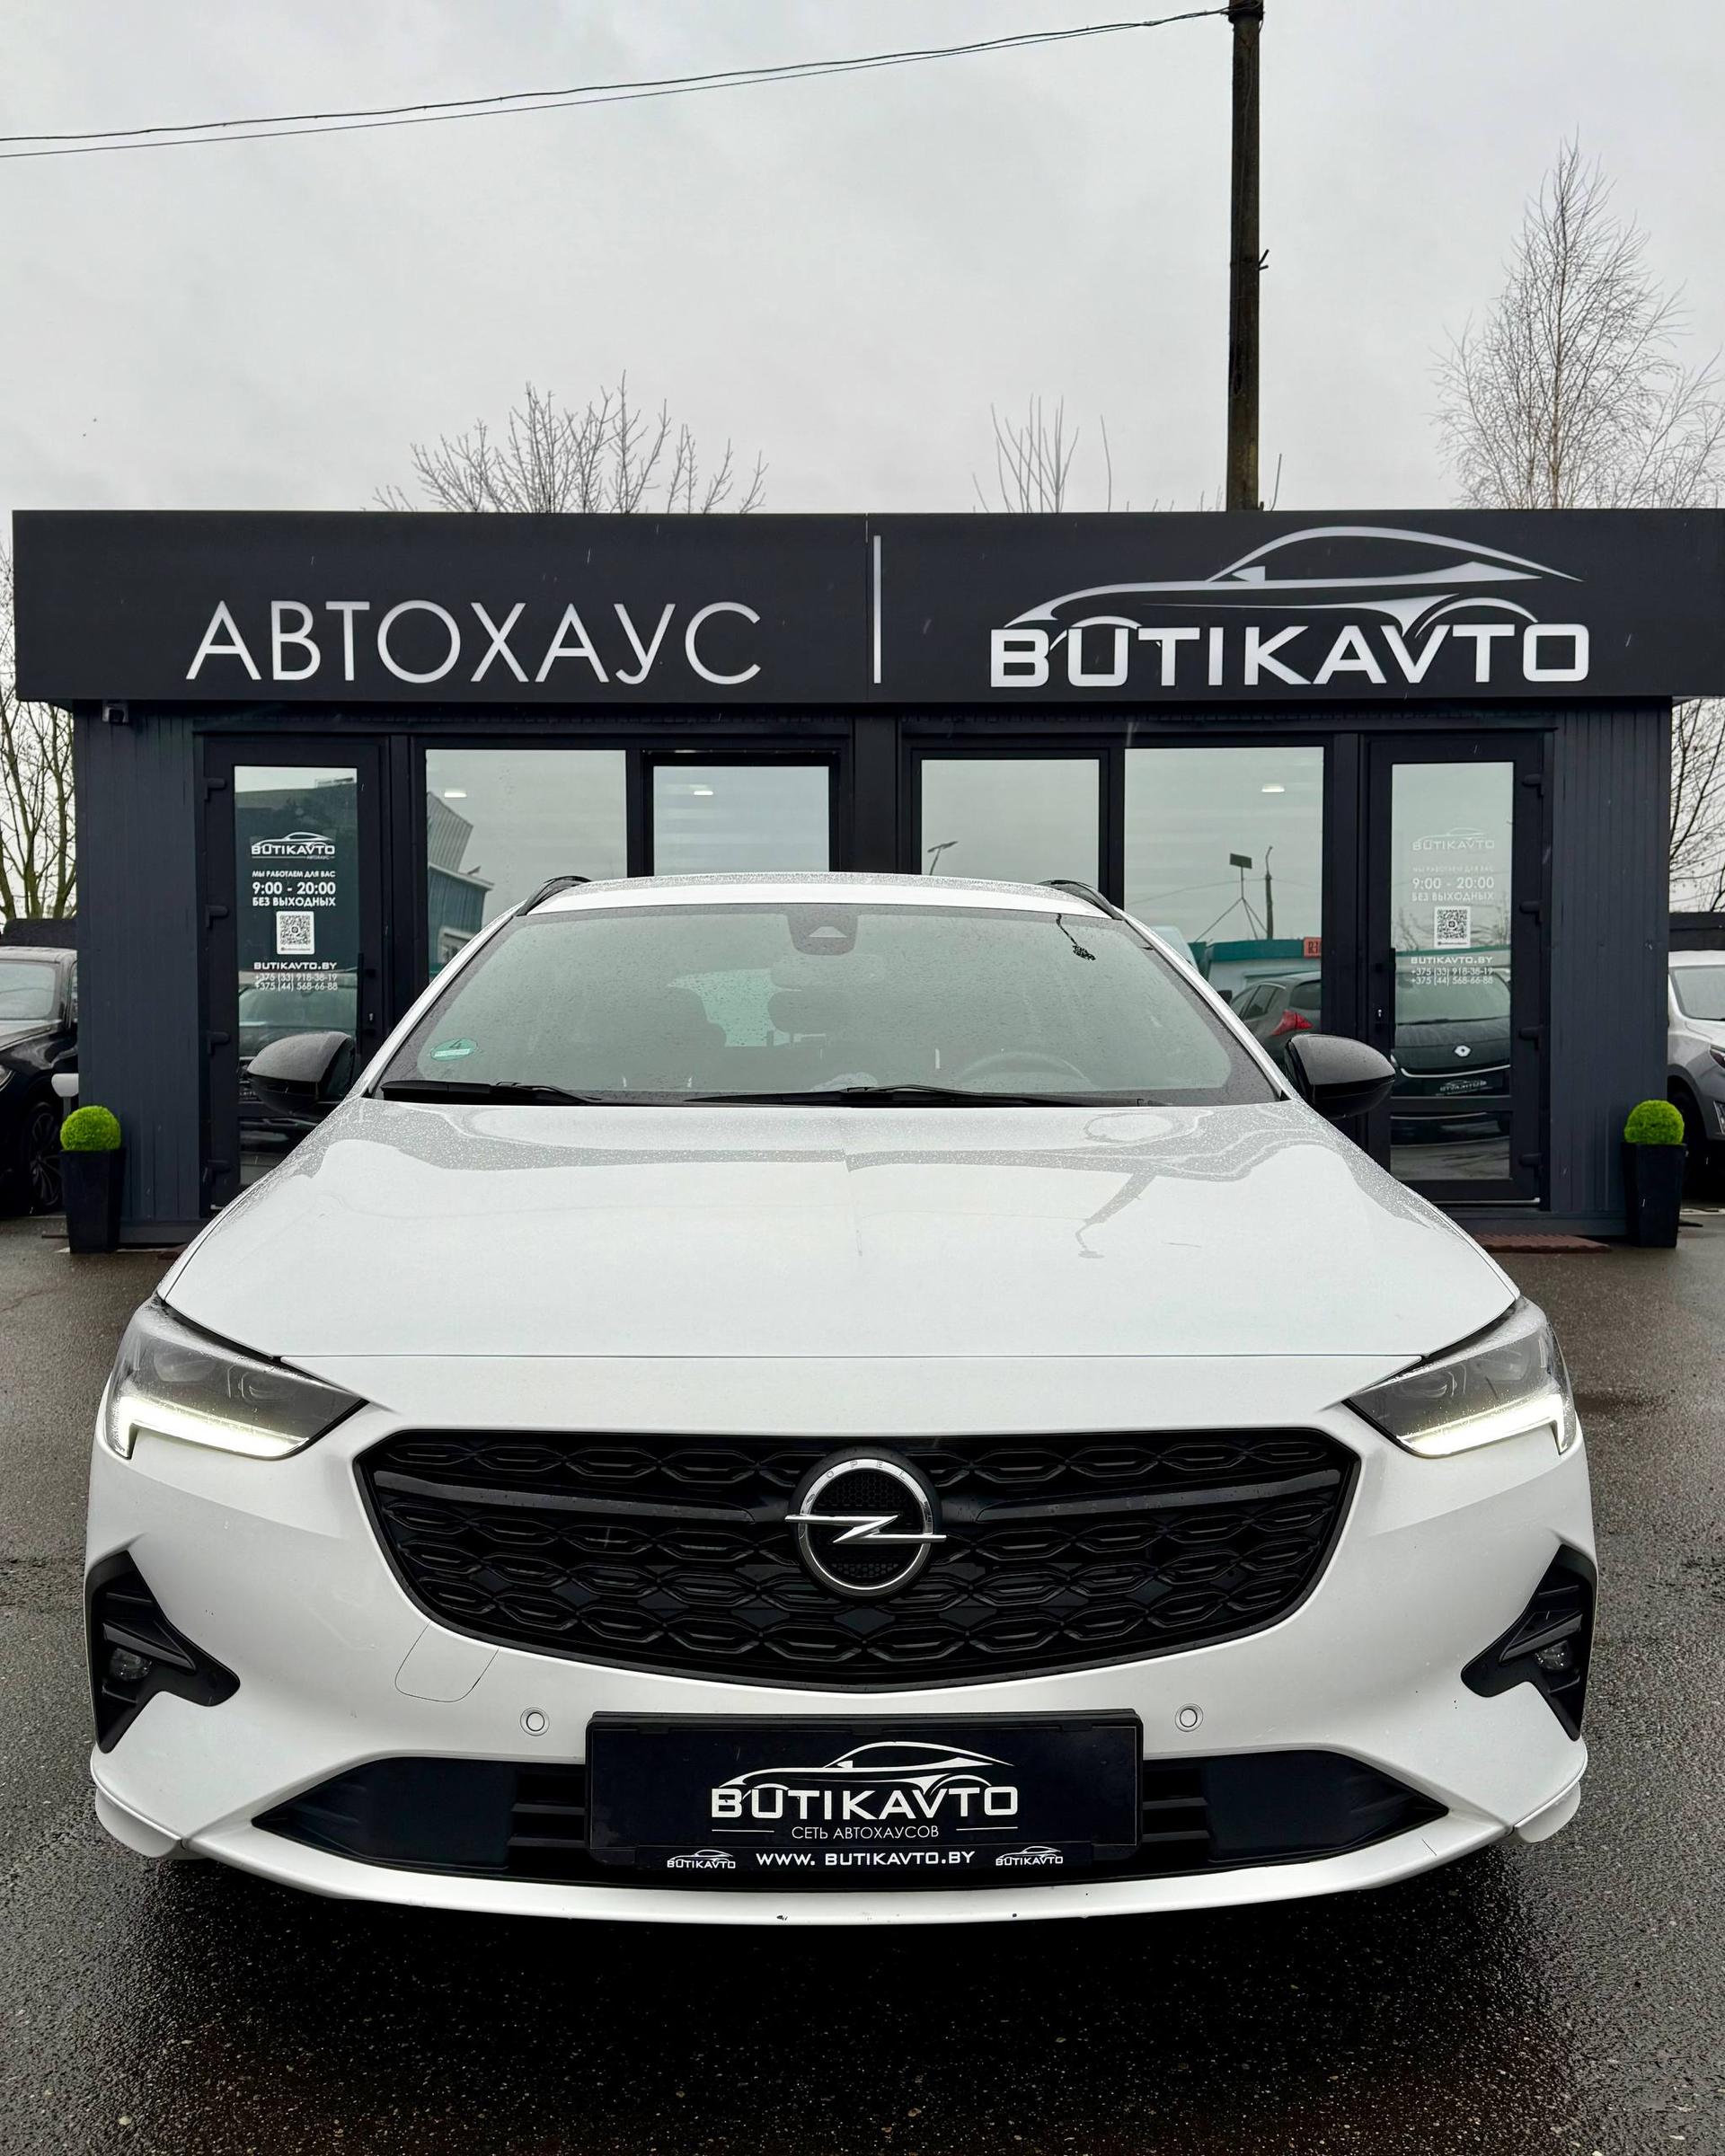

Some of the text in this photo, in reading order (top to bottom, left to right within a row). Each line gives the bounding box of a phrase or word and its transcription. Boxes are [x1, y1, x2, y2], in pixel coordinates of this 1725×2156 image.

[186, 599, 762, 685] АВТОХАУС
[990, 623, 1589, 688] BUTIKAVTO
[252, 844, 336, 854] BUTIKAVTO
[1412, 840, 1495, 851] BUTIKAVTO
[252, 881, 283, 895] 9:00
[296, 881, 336, 895] 20:00
[1412, 877, 1441, 889] 9:00
[1456, 877, 1495, 888] 20:00
[252, 897, 336, 907] БЕЗ ВЫХОДНЫХ
[1411, 891, 1494, 902] БЕЗ ВЫХОДНЫХ
[253, 962, 337, 970] BUTIKAVTO.BY
[1411, 968, 1431, 976] +375
[1434, 967, 1449, 977] (33)
[278, 973, 294, 983] (33)
[1411, 976, 1431, 985] +375
[1434, 976, 1449, 986] (44)
[278, 981, 294, 992] (44)
[827, 1460, 906, 1480] OPEL
[711, 1786, 1019, 1820] BUTIKAVTO
[792, 1825, 940, 1840] СЕТЬ АВТОХАУСОВ
[667, 1860, 736, 1869] BUTIKAVTO
[756, 1851, 976, 1867] WWW. BUTIKAVTO.BY
[995, 1856, 1064, 1867] BUTIKAVTO
